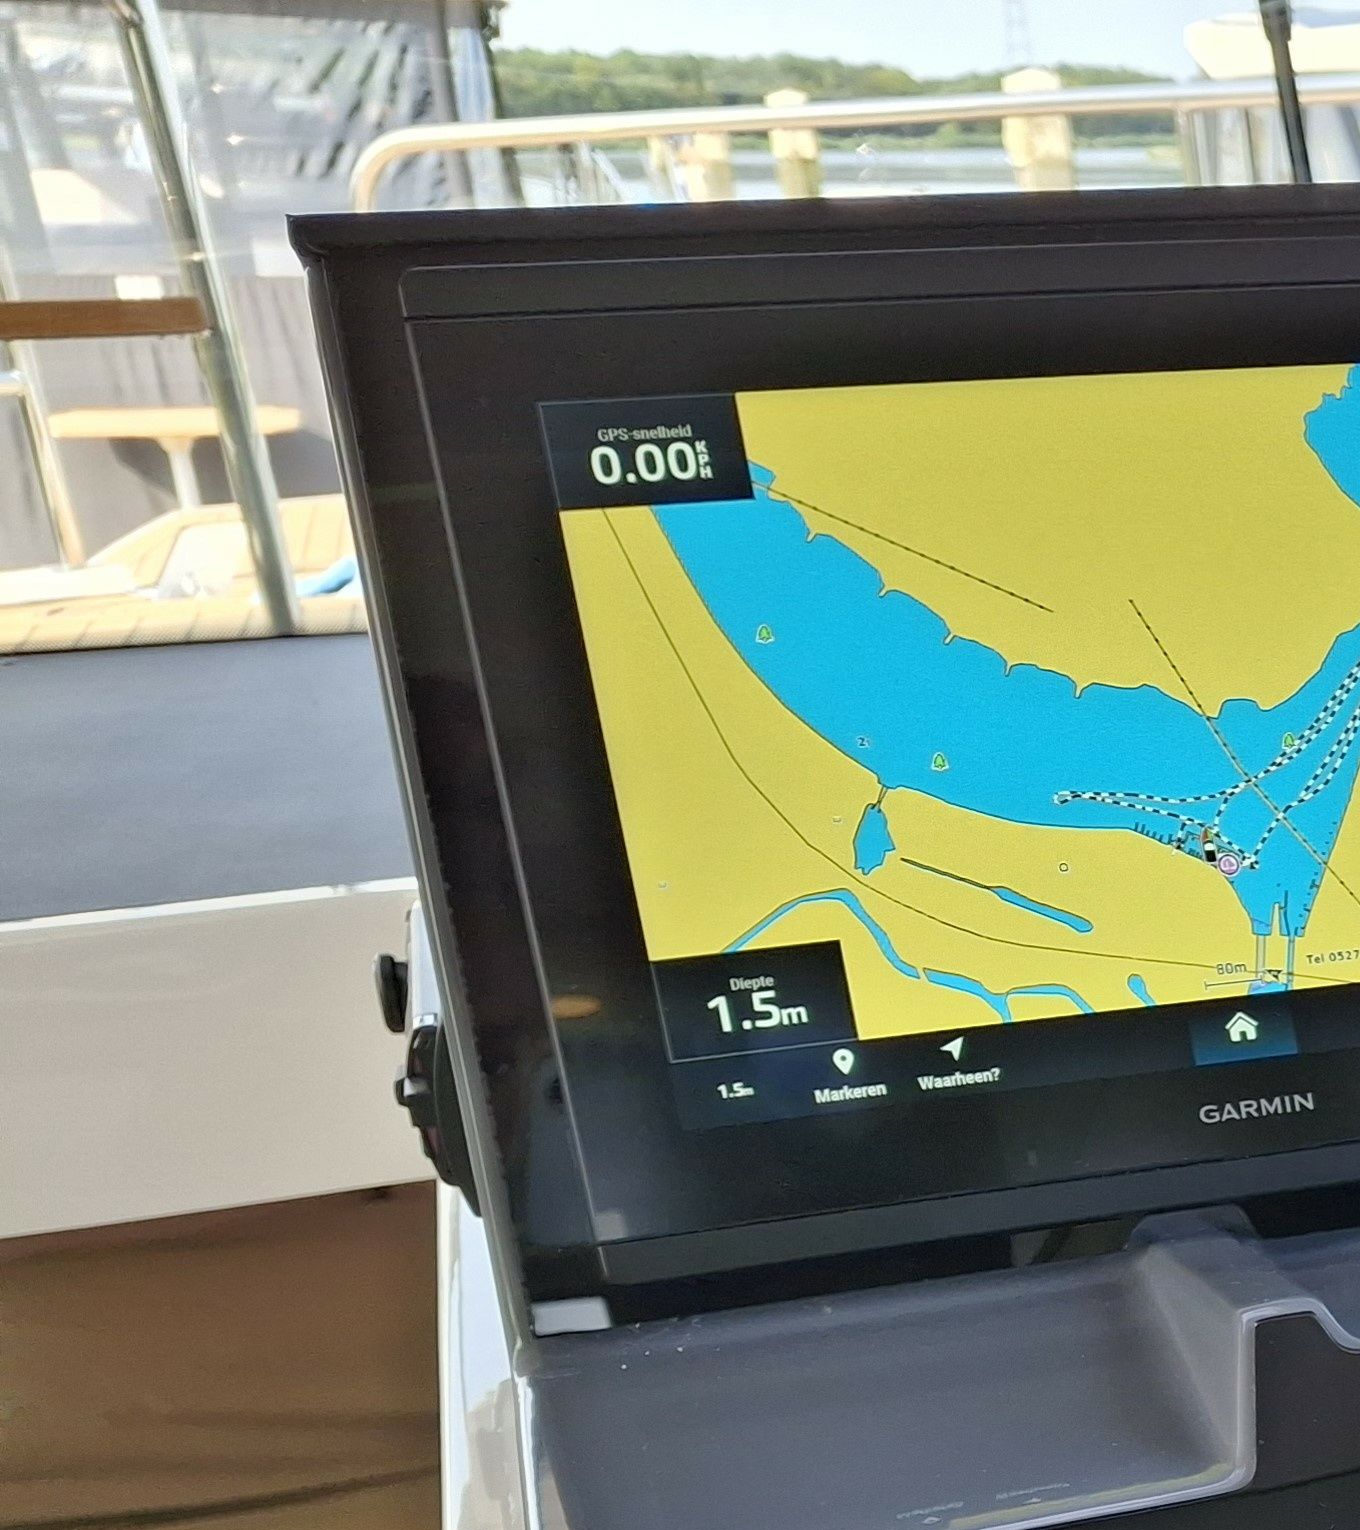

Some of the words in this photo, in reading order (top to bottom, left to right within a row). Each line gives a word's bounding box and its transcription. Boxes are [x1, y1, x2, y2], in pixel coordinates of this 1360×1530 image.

[597, 424, 693, 442] GPS-snelheid
[590, 440, 698, 485] 0.00
[1305, 952, 1325, 965] Tel
[729, 974, 775, 992] Diepte
[706, 989, 809, 1033] 1.5m
[916, 1067, 1001, 1092] Waarheen?
[813, 1082, 887, 1104] Markeren
[1199, 1092, 1315, 1124] GARMIN
